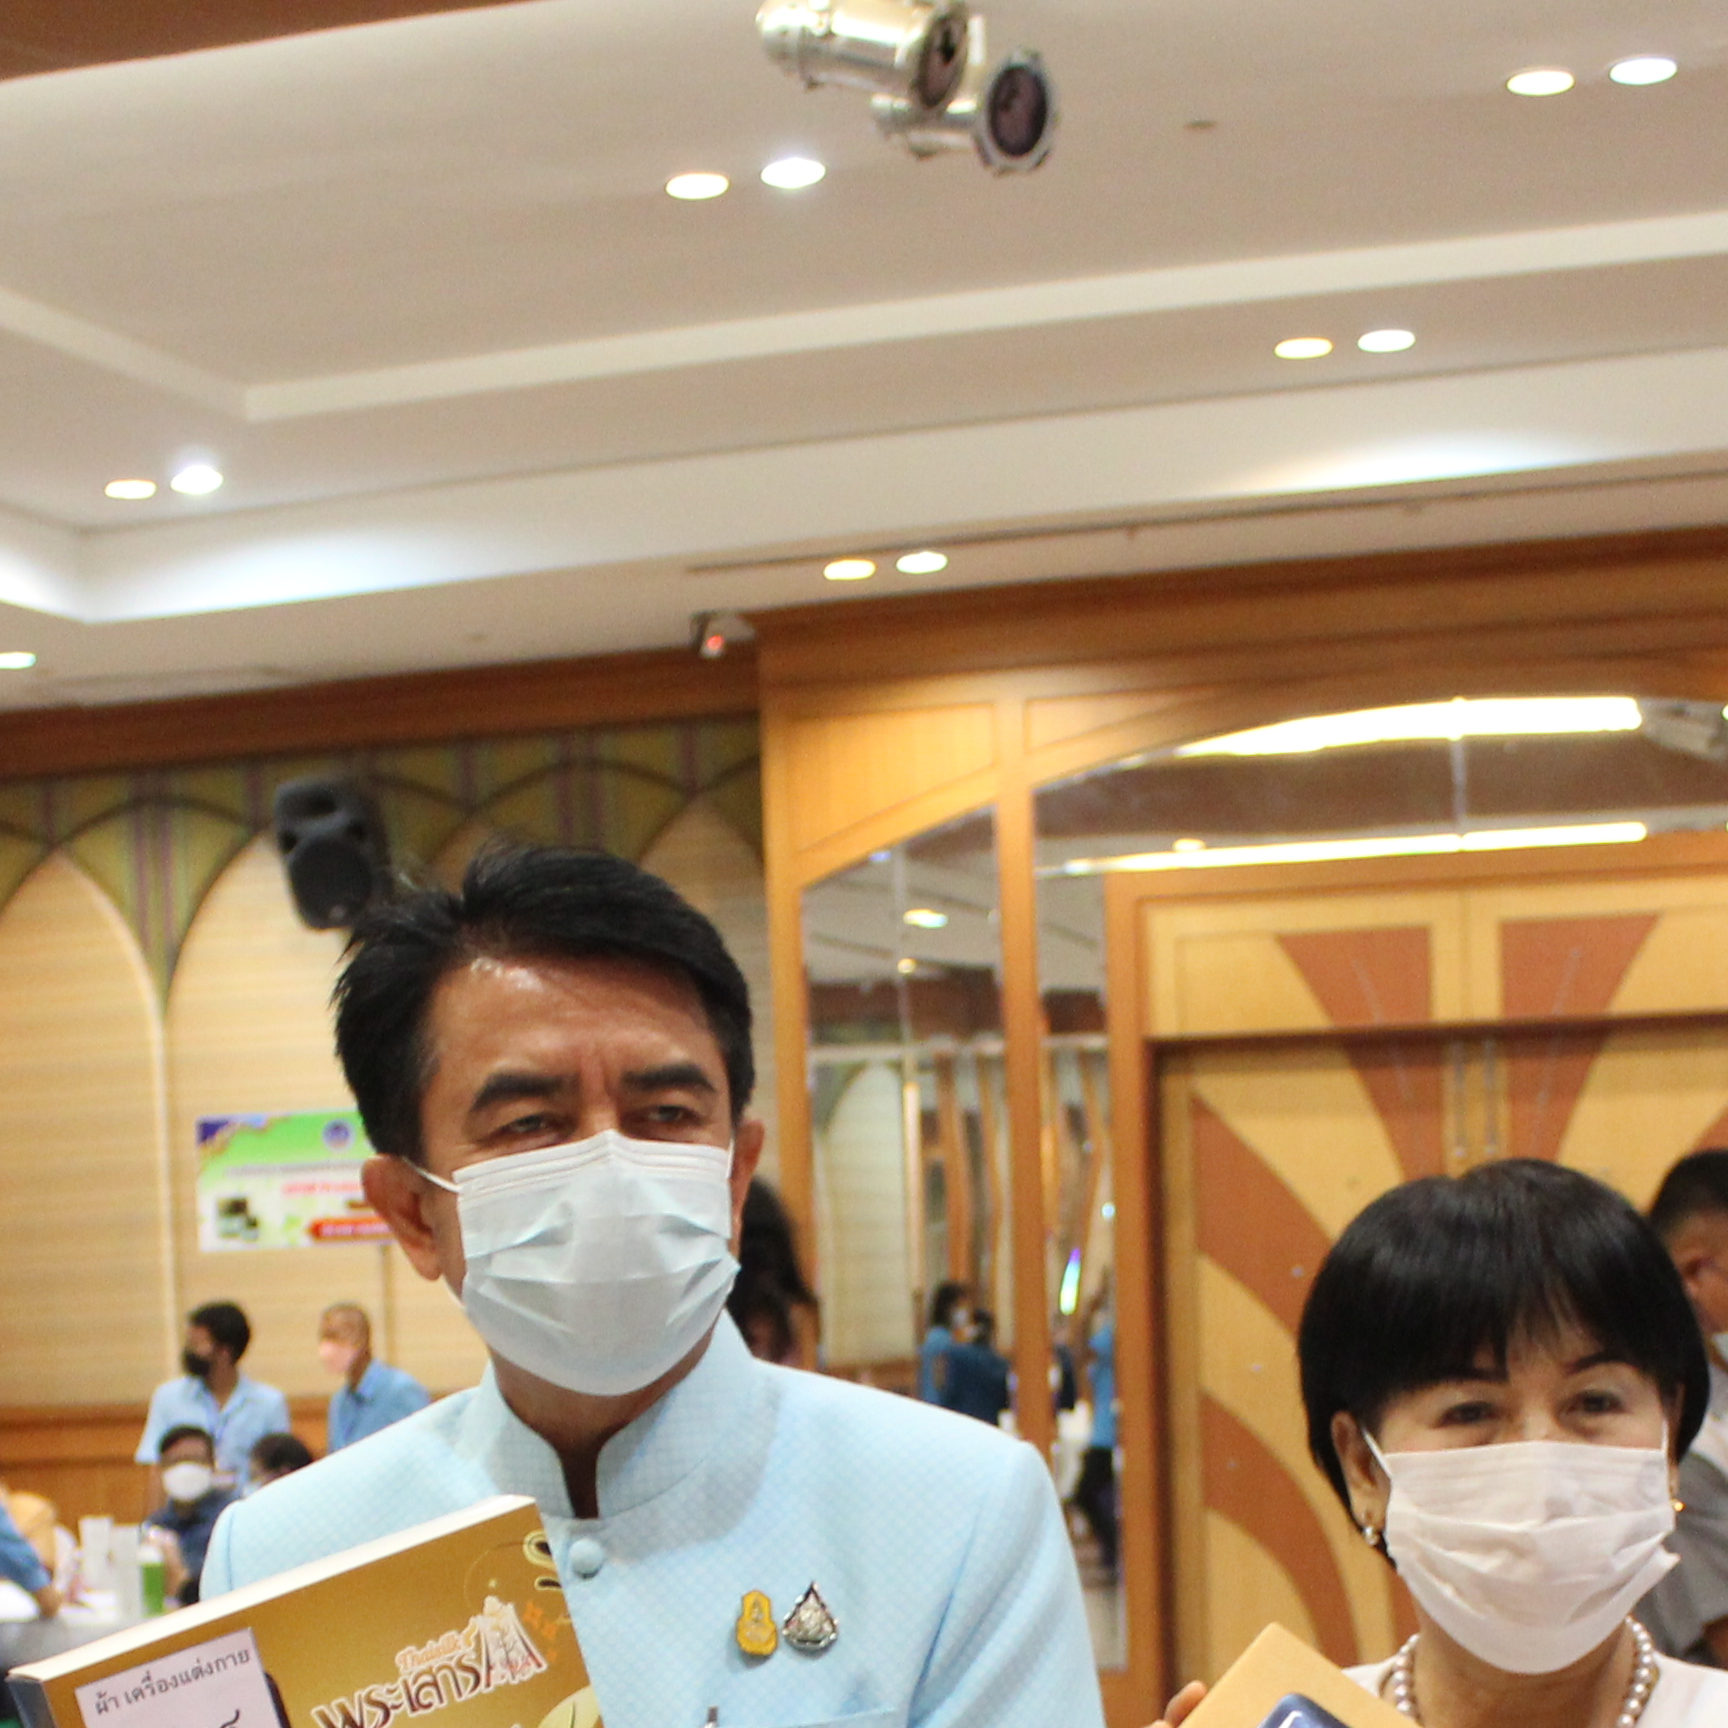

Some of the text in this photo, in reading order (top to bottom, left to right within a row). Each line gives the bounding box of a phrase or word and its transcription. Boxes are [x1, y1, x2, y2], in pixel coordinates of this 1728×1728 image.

[94, 1648, 250, 1715] ผ้า เครื่องแต่งกาย
